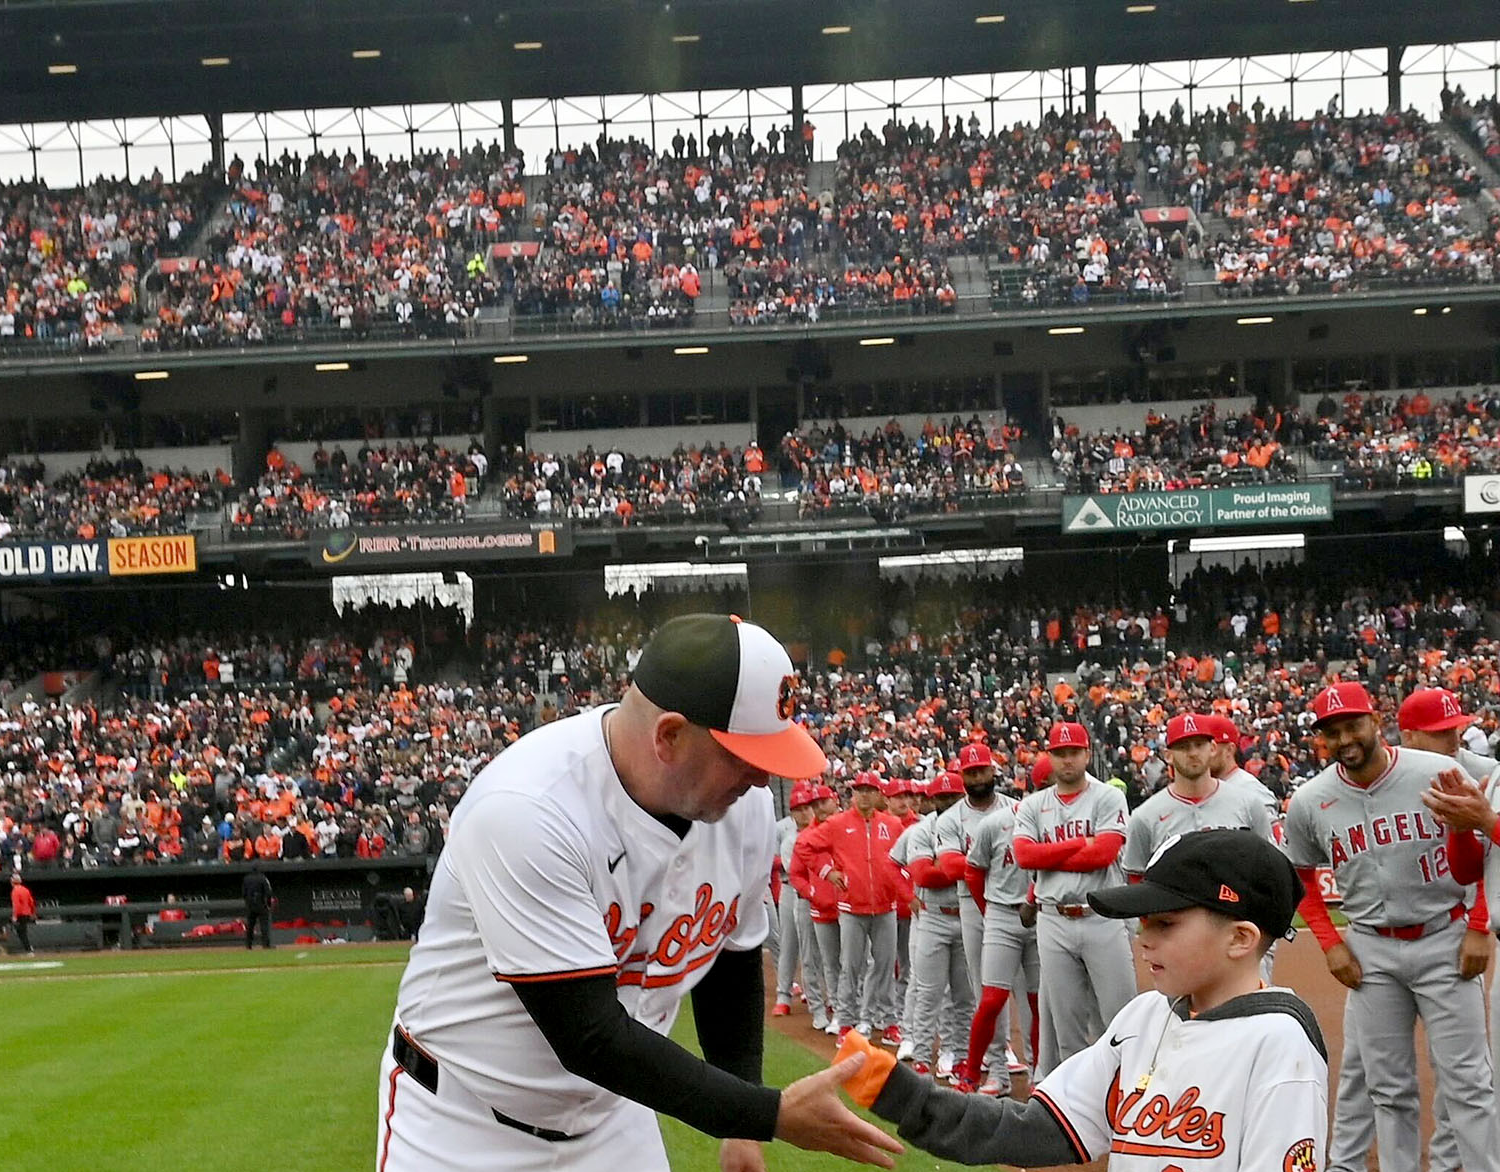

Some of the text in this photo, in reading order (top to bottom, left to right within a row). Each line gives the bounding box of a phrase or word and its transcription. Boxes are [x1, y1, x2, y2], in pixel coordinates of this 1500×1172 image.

[1118, 495, 1199, 510] ADVANCED
[1233, 490, 1311, 505] Proud Imaging
[1117, 509, 1204, 528] RADIOLOGY
[1217, 504, 1328, 521] Partner of the Orioles
[115, 540, 188, 569] SEASON
[1417, 843, 1449, 885] 12
